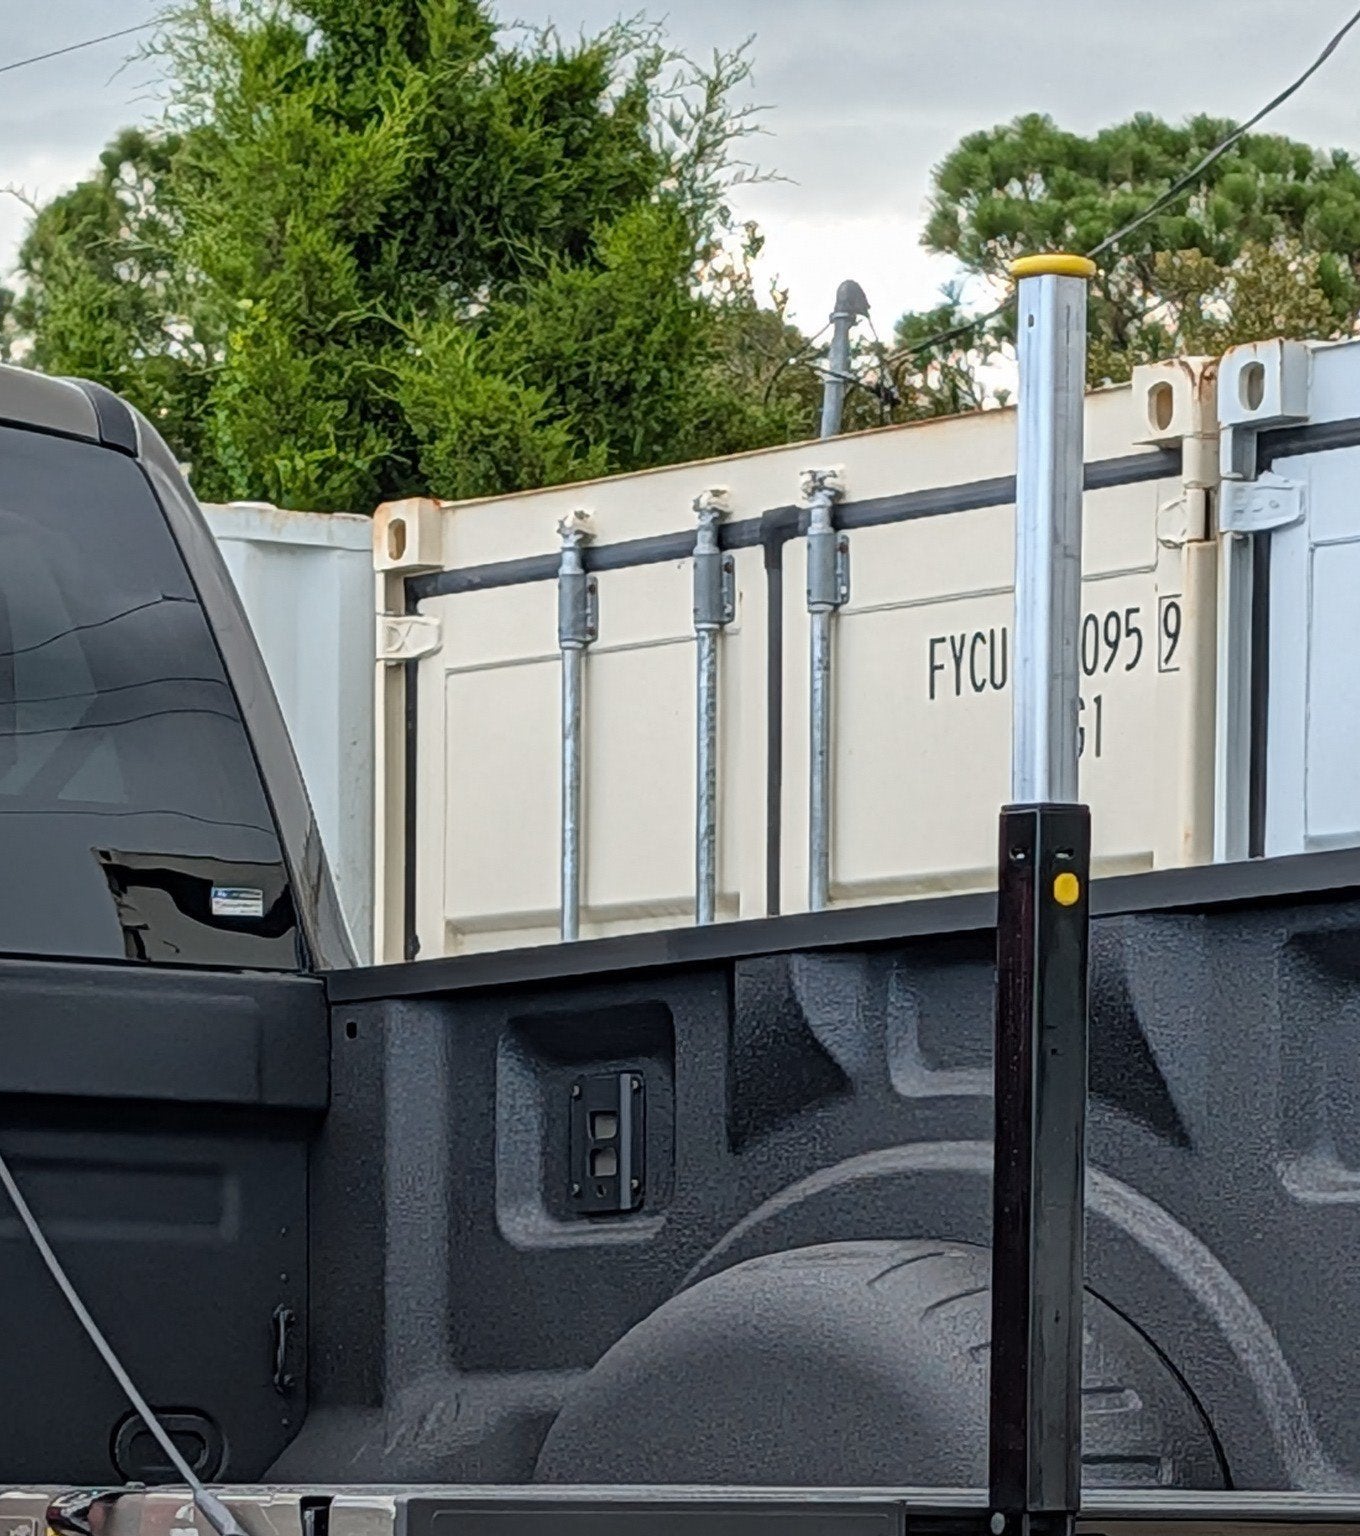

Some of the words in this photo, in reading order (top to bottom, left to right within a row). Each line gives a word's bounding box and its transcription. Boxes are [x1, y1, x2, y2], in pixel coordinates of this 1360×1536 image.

[929, 626, 1008, 699] FYCU
[1080, 607, 1143, 676] 095
[1160, 599, 1182, 667] 9
